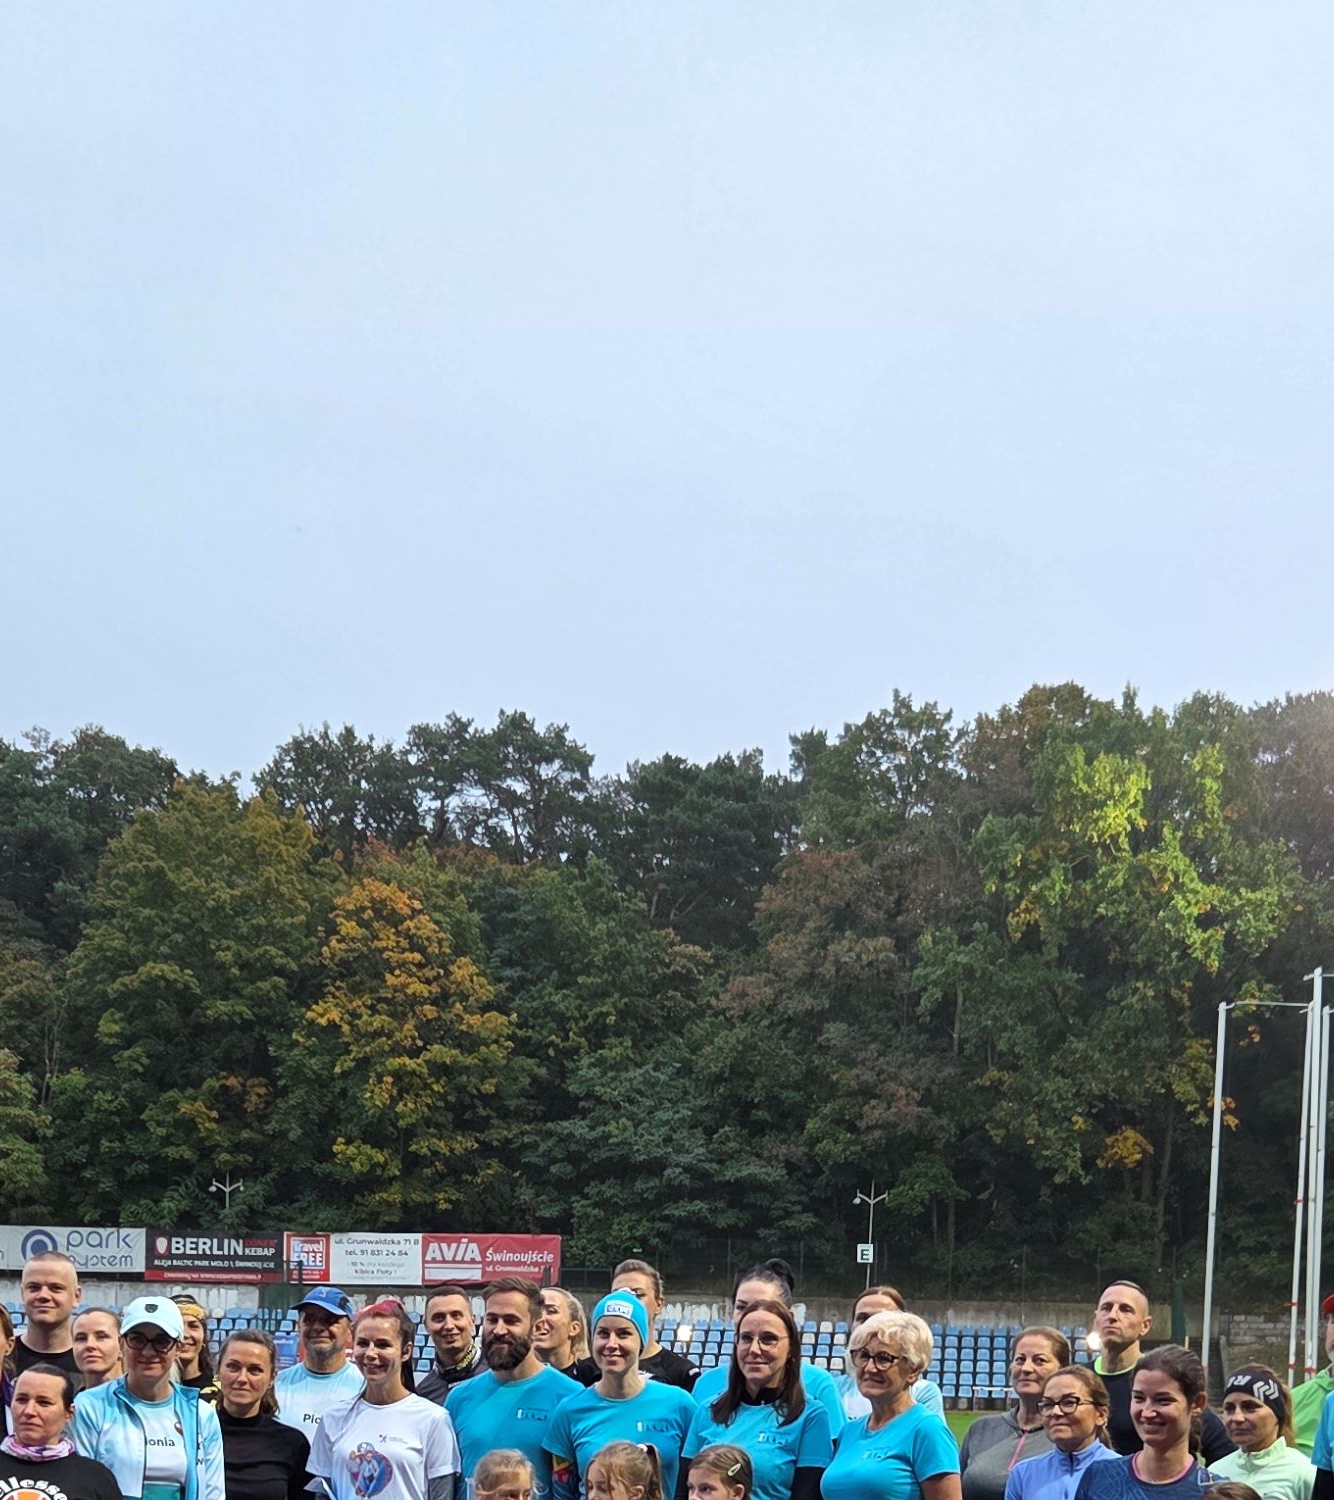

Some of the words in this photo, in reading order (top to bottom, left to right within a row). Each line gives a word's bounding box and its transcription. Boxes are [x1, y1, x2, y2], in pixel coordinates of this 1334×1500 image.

[67, 1230, 133, 1251] park
[171, 1237, 244, 1255] BERLIN
[292, 1240, 324, 1252] Travel
[346, 1238, 401, 1246] Grunwaldzka
[244, 1247, 275, 1256] KEBAP
[485, 1247, 554, 1264] Świnoujście
[860, 1249, 869, 1260] E
[293, 1252, 323, 1266] FREE
[145, 1436, 176, 1447] onia
